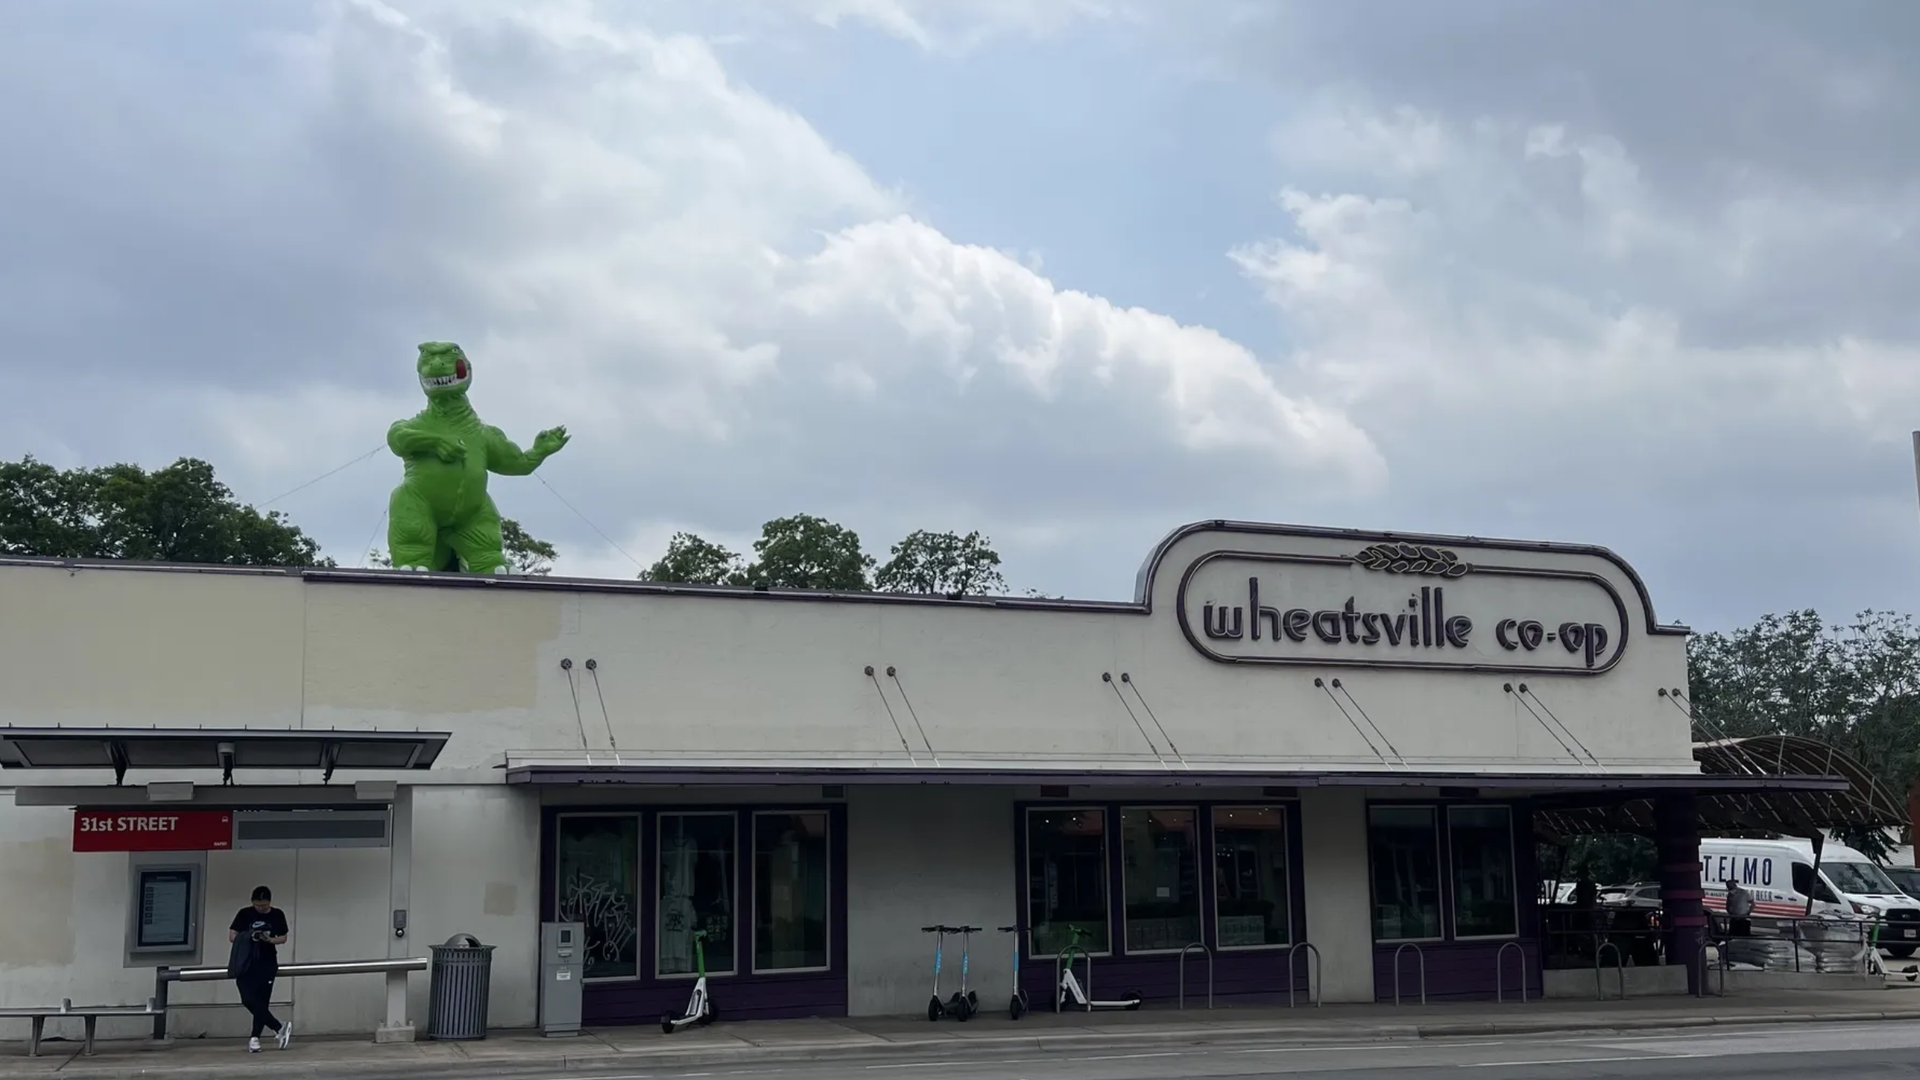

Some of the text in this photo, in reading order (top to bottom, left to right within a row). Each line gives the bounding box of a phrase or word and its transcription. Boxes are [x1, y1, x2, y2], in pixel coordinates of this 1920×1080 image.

[1203, 577, 1608, 667] wheatsville co-op
[80, 816, 178, 832] 31st STREET
[1703, 856, 1772, 885] T.ELMO
